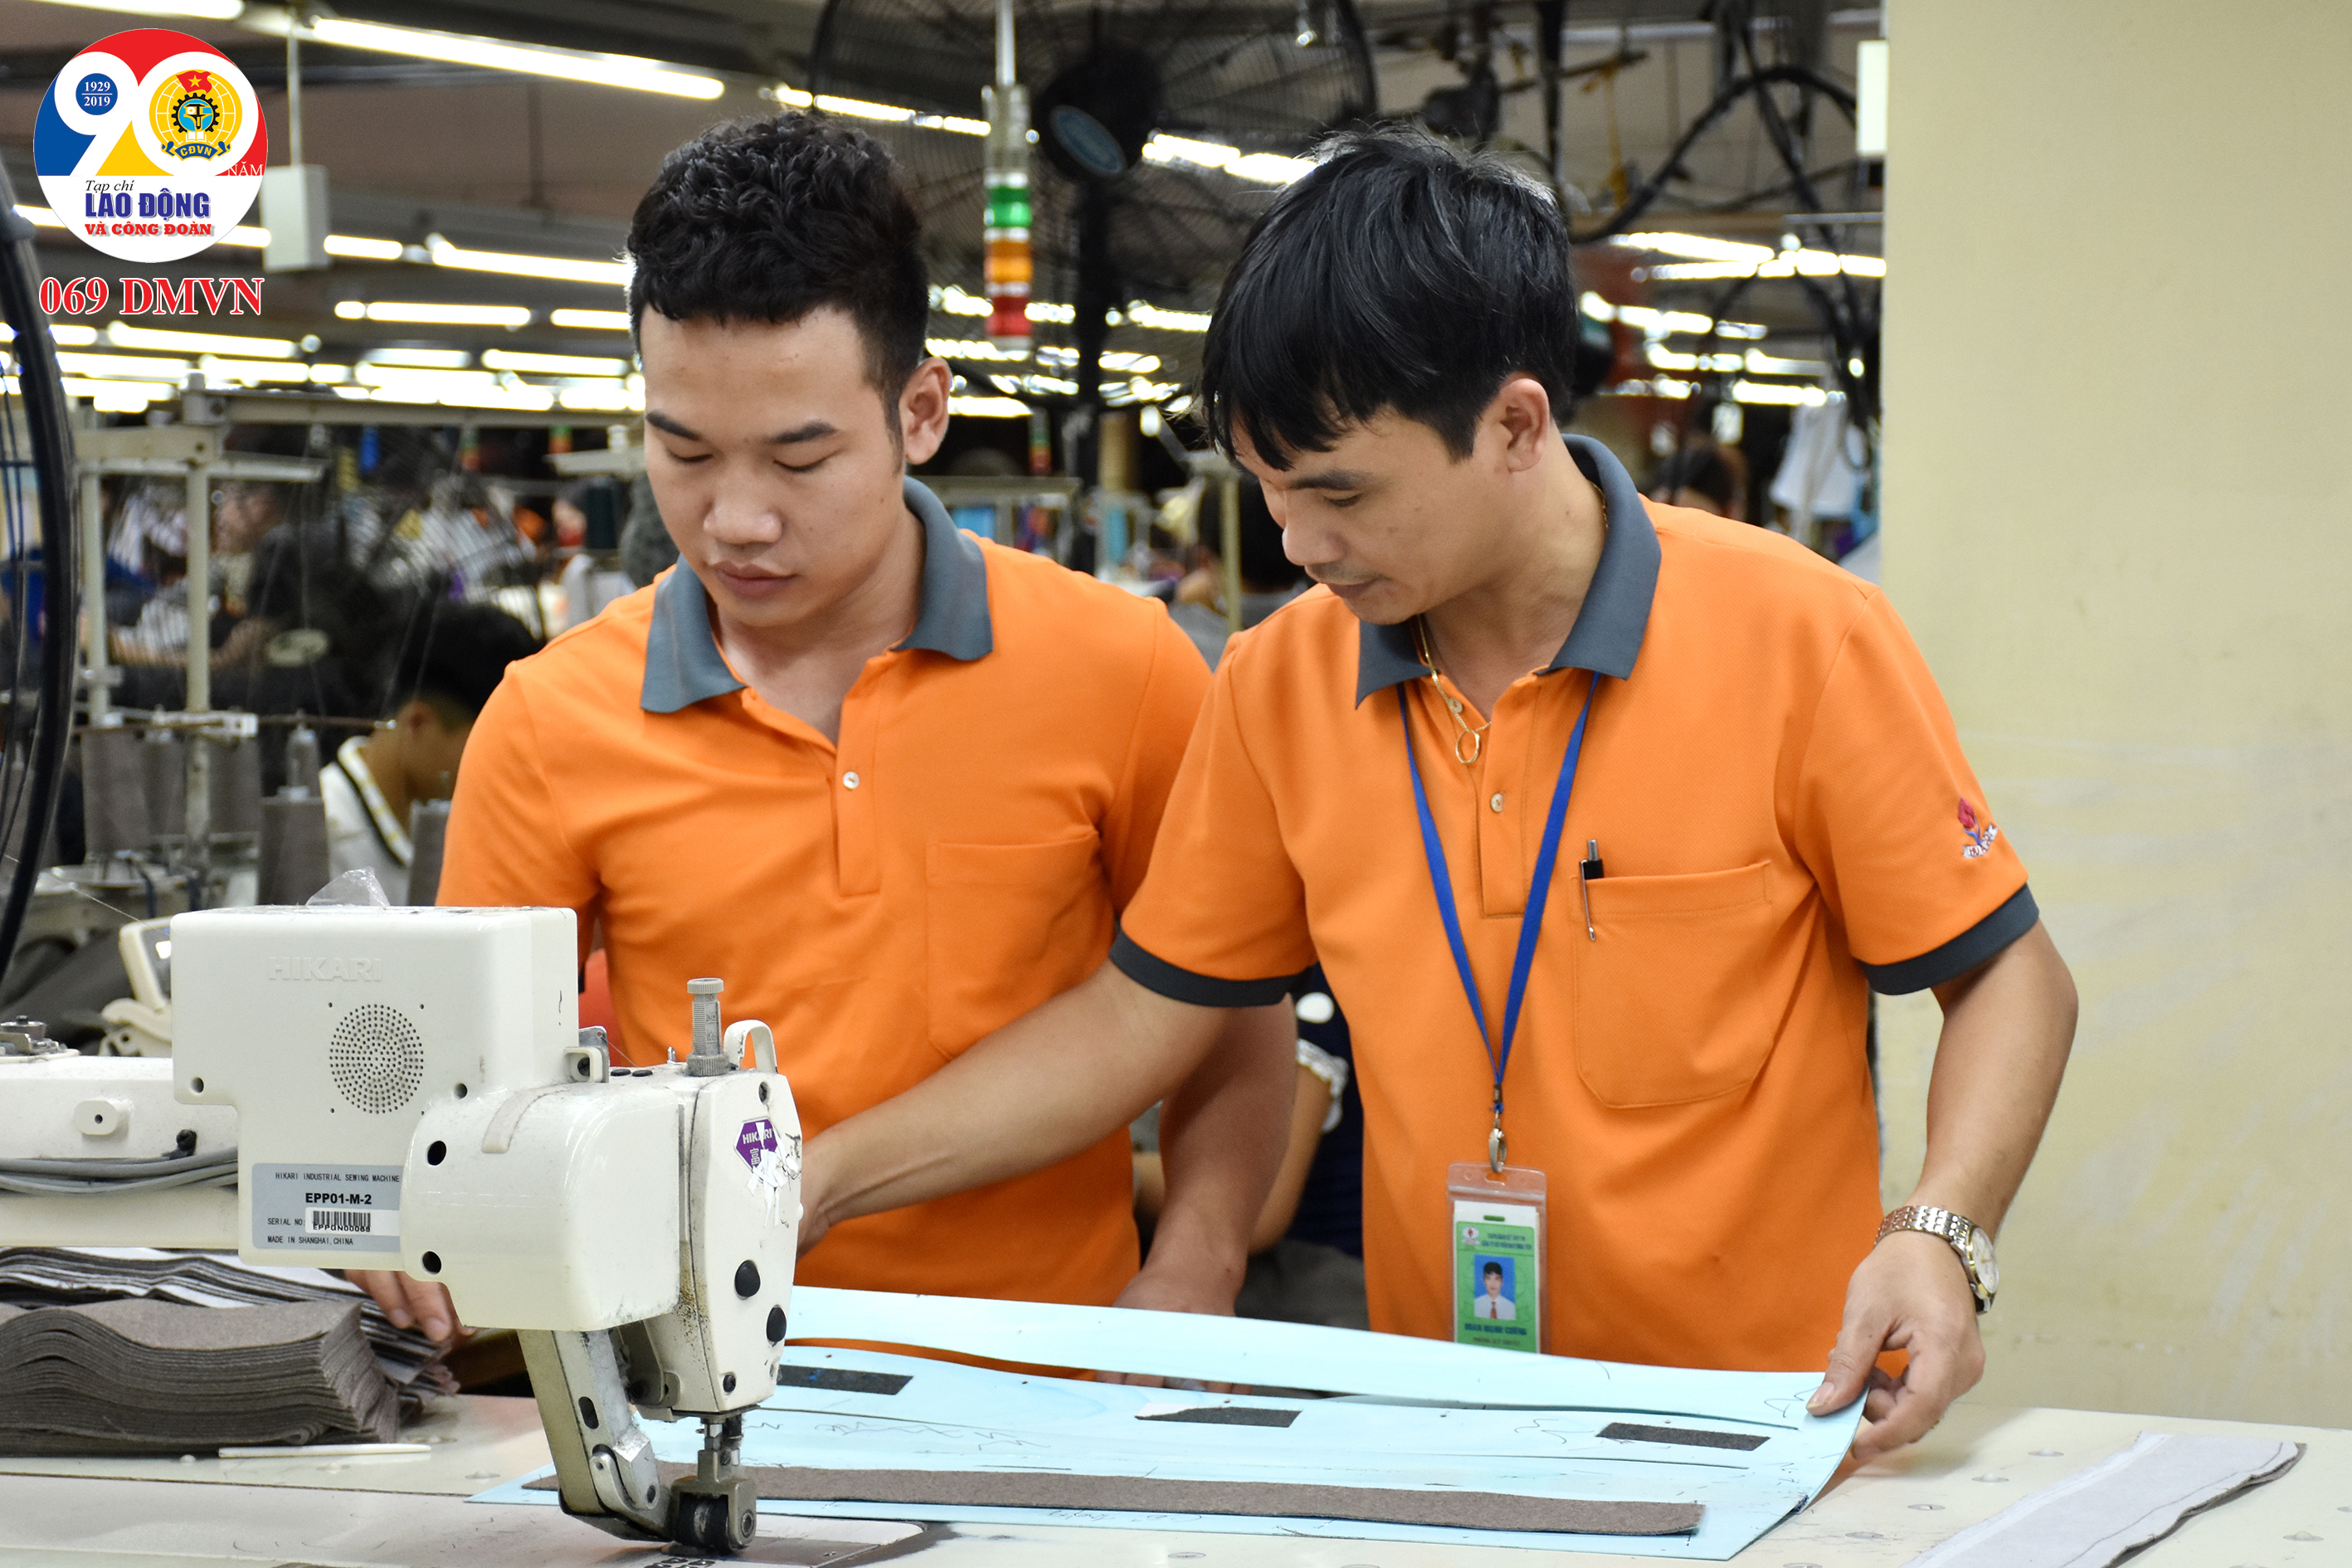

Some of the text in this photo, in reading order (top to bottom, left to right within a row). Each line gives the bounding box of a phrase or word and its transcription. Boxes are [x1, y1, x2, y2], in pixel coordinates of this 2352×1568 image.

[267, 957, 382, 982] HIKARI
[275, 1172, 400, 1183] HIKARI INDUSTRIAL SEWING MACHINE
[305, 1192, 373, 1205] EPP01-M-2
[267, 1217, 290, 1226] SERIAL
[267, 1235, 284, 1244] MADE
